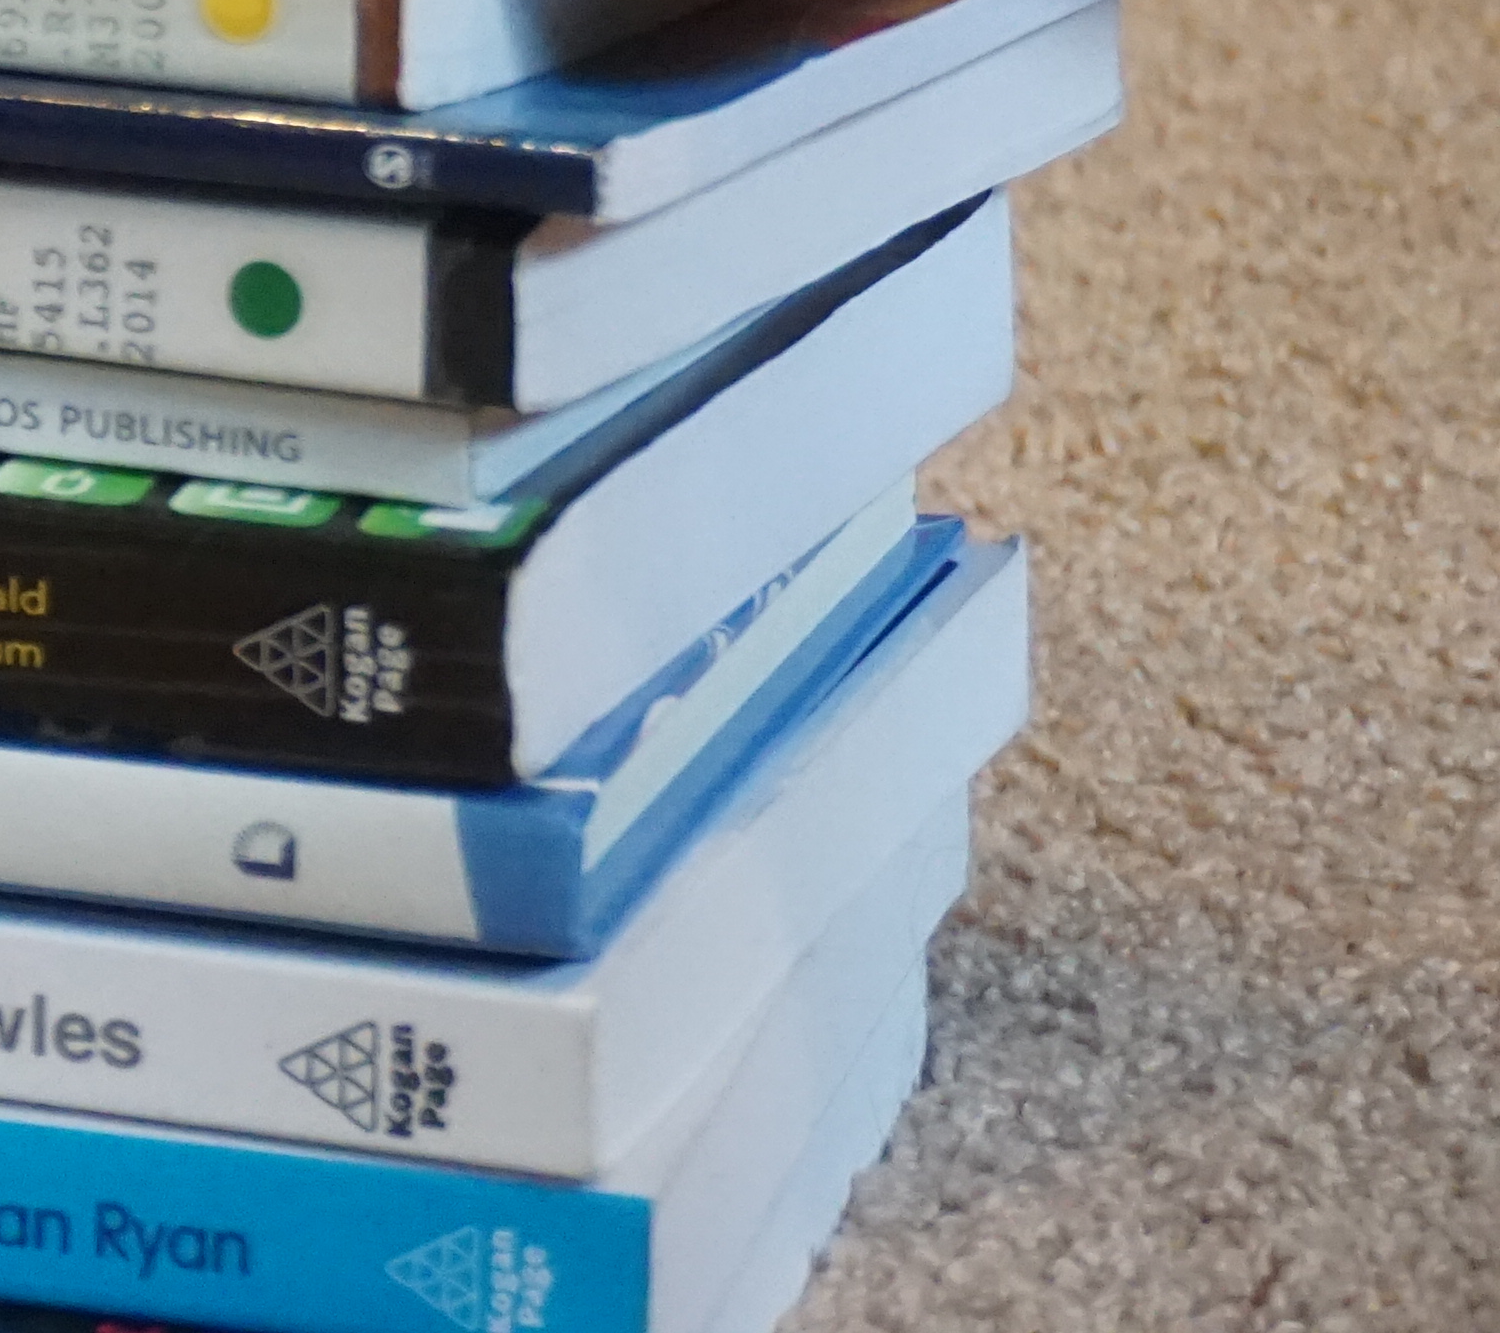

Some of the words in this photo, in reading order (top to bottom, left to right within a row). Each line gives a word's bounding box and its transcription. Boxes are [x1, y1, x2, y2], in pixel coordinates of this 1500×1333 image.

[121, 259, 157, 362] 2014
[61, 404, 302, 463] PUBLISHING
[339, 606, 376, 722] Kogan
[373, 625, 411, 713] Page
[386, 1024, 421, 1137] Kogan
[418, 1042, 454, 1128] Page
[96, 1200, 251, 1280] Ryan
